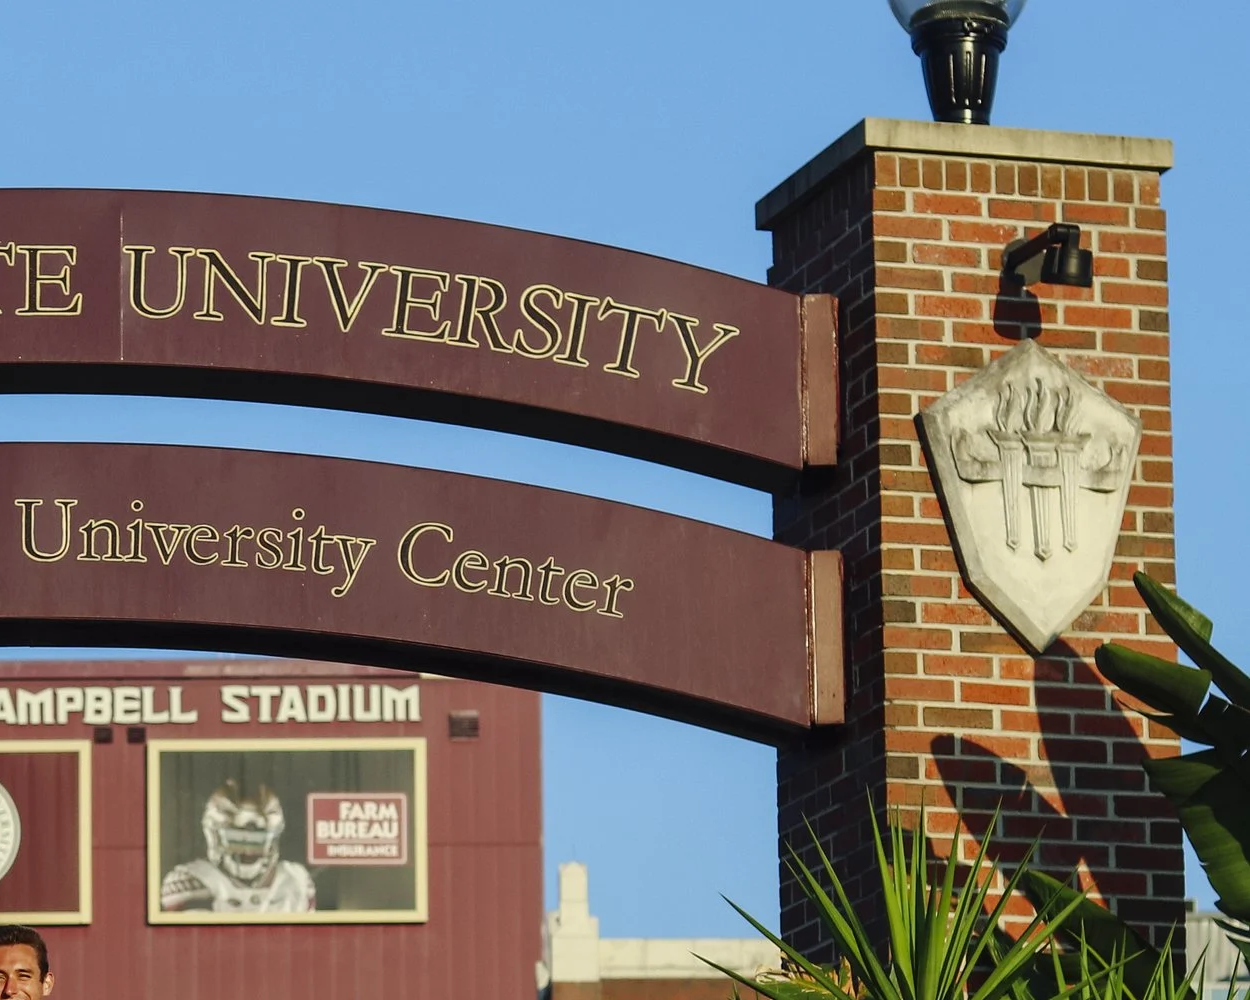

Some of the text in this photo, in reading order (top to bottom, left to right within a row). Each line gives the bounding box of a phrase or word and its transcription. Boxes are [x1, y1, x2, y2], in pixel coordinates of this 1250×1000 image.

[124, 245, 739, 394] UNIVERSITY
[16, 498, 376, 597] University
[398, 522, 634, 620] Center
[221, 684, 422, 723] STADIUM
[316, 820, 399, 839] BUREAU
[339, 801, 399, 820] FARM
